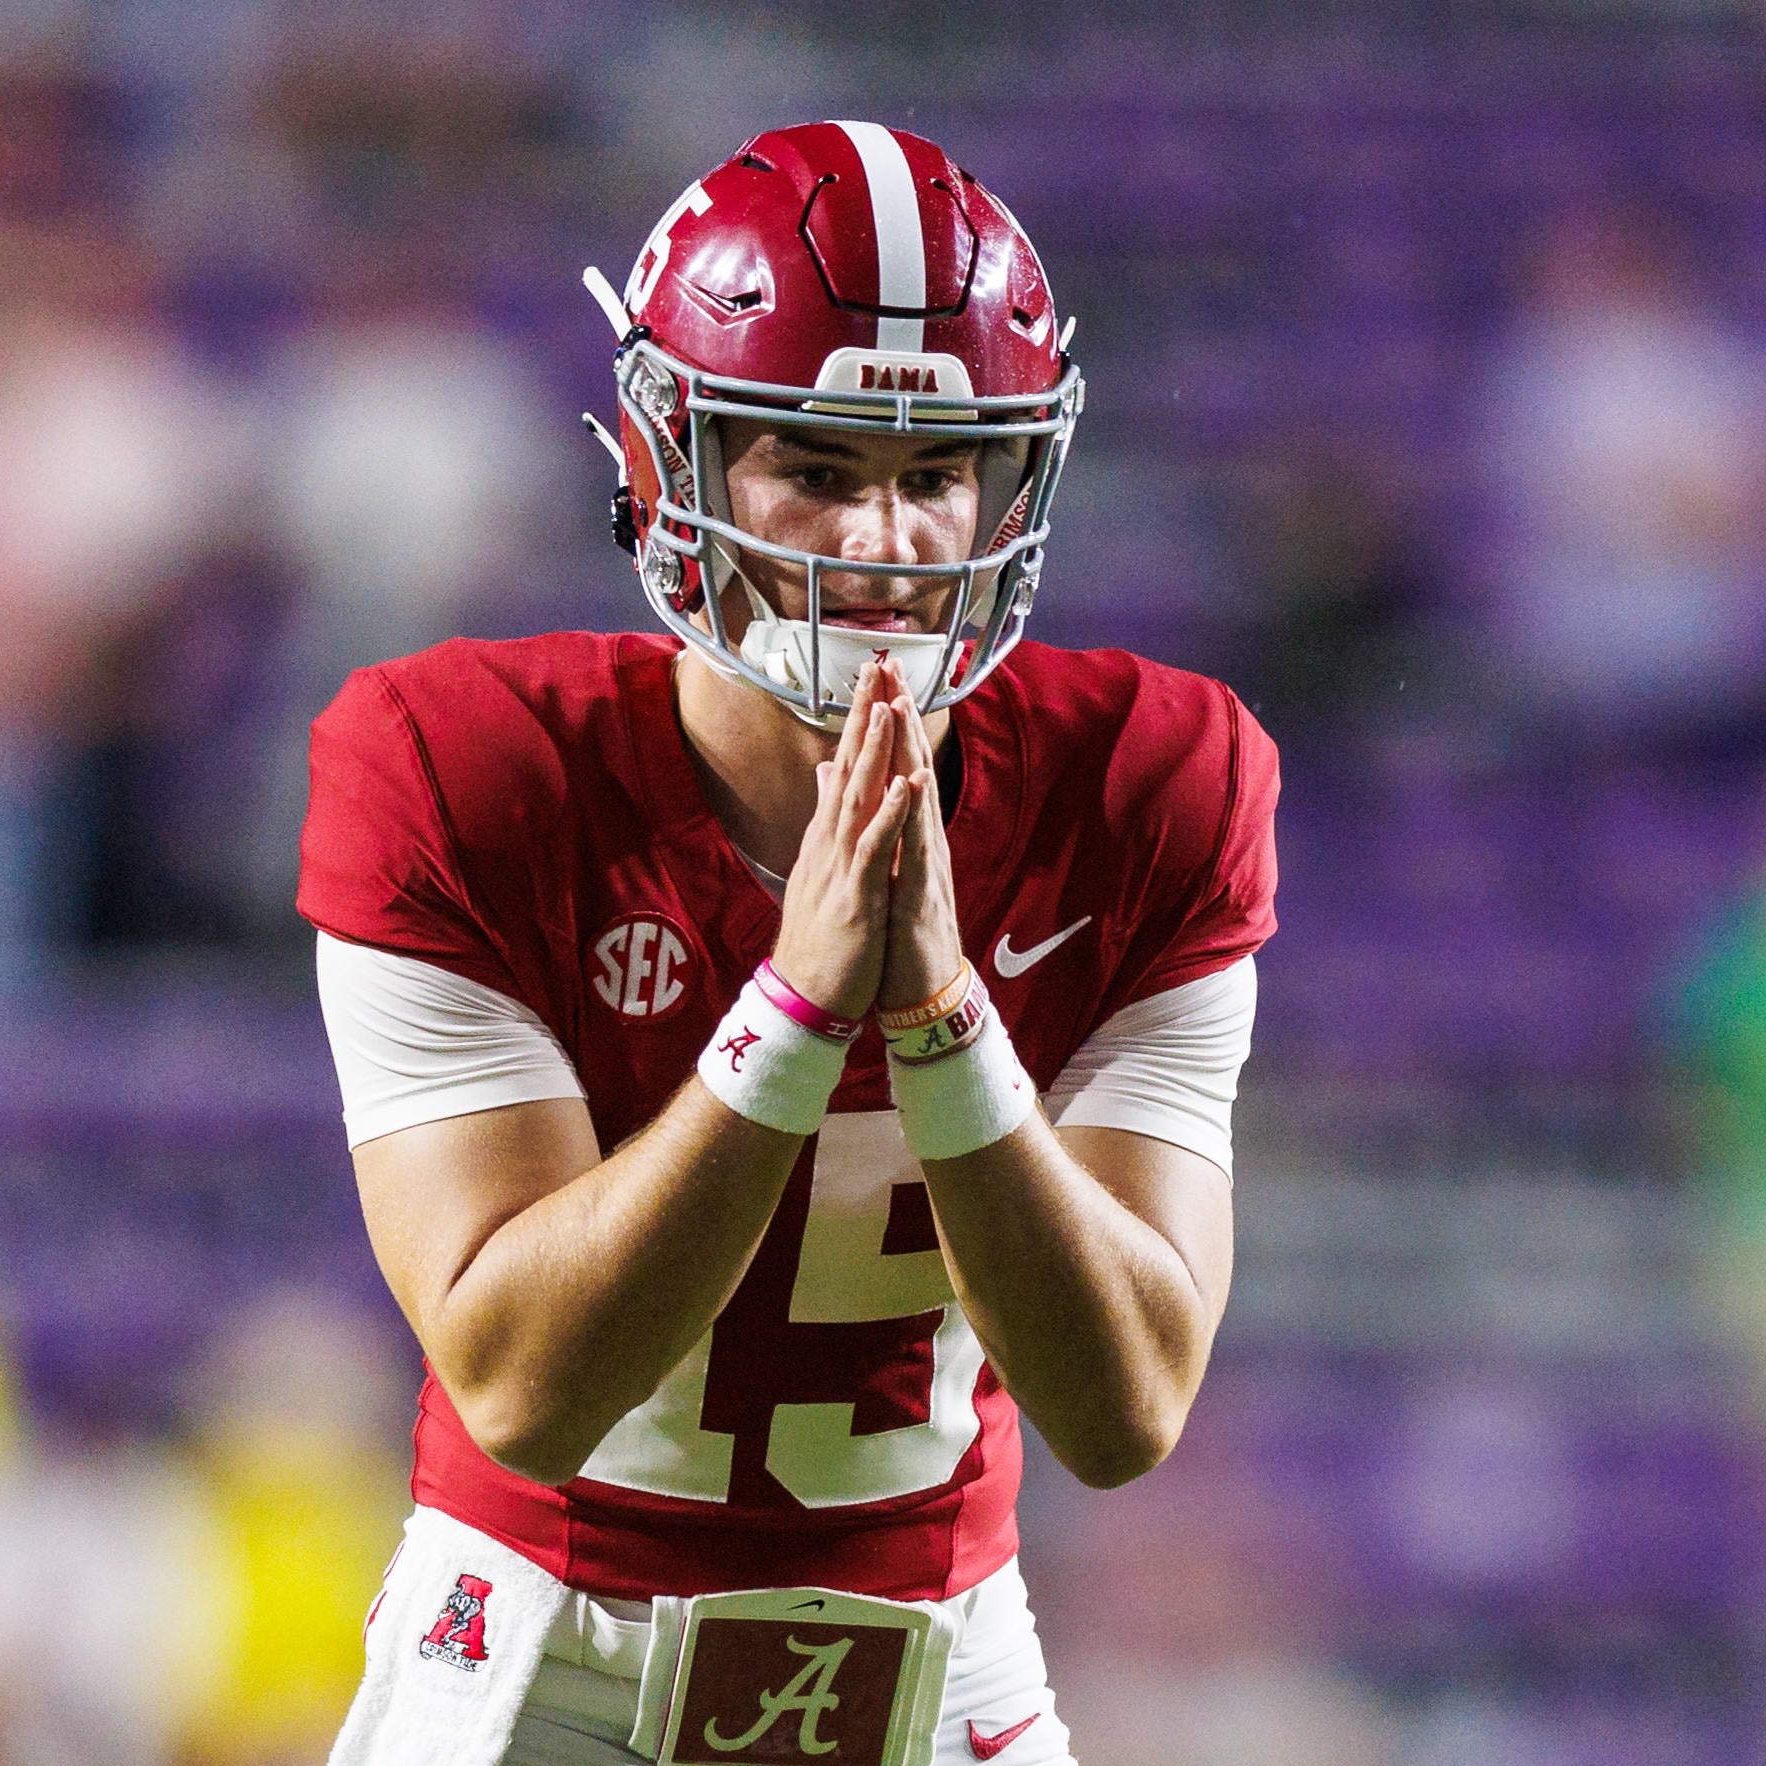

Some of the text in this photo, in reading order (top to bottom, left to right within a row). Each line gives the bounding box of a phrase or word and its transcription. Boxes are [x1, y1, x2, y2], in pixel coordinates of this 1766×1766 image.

[860, 364, 939, 393] BAMA
[593, 921, 687, 1016] SEC
[717, 1025, 762, 1073] A
[917, 1024, 946, 1054] A
[704, 1633, 855, 1756] A
